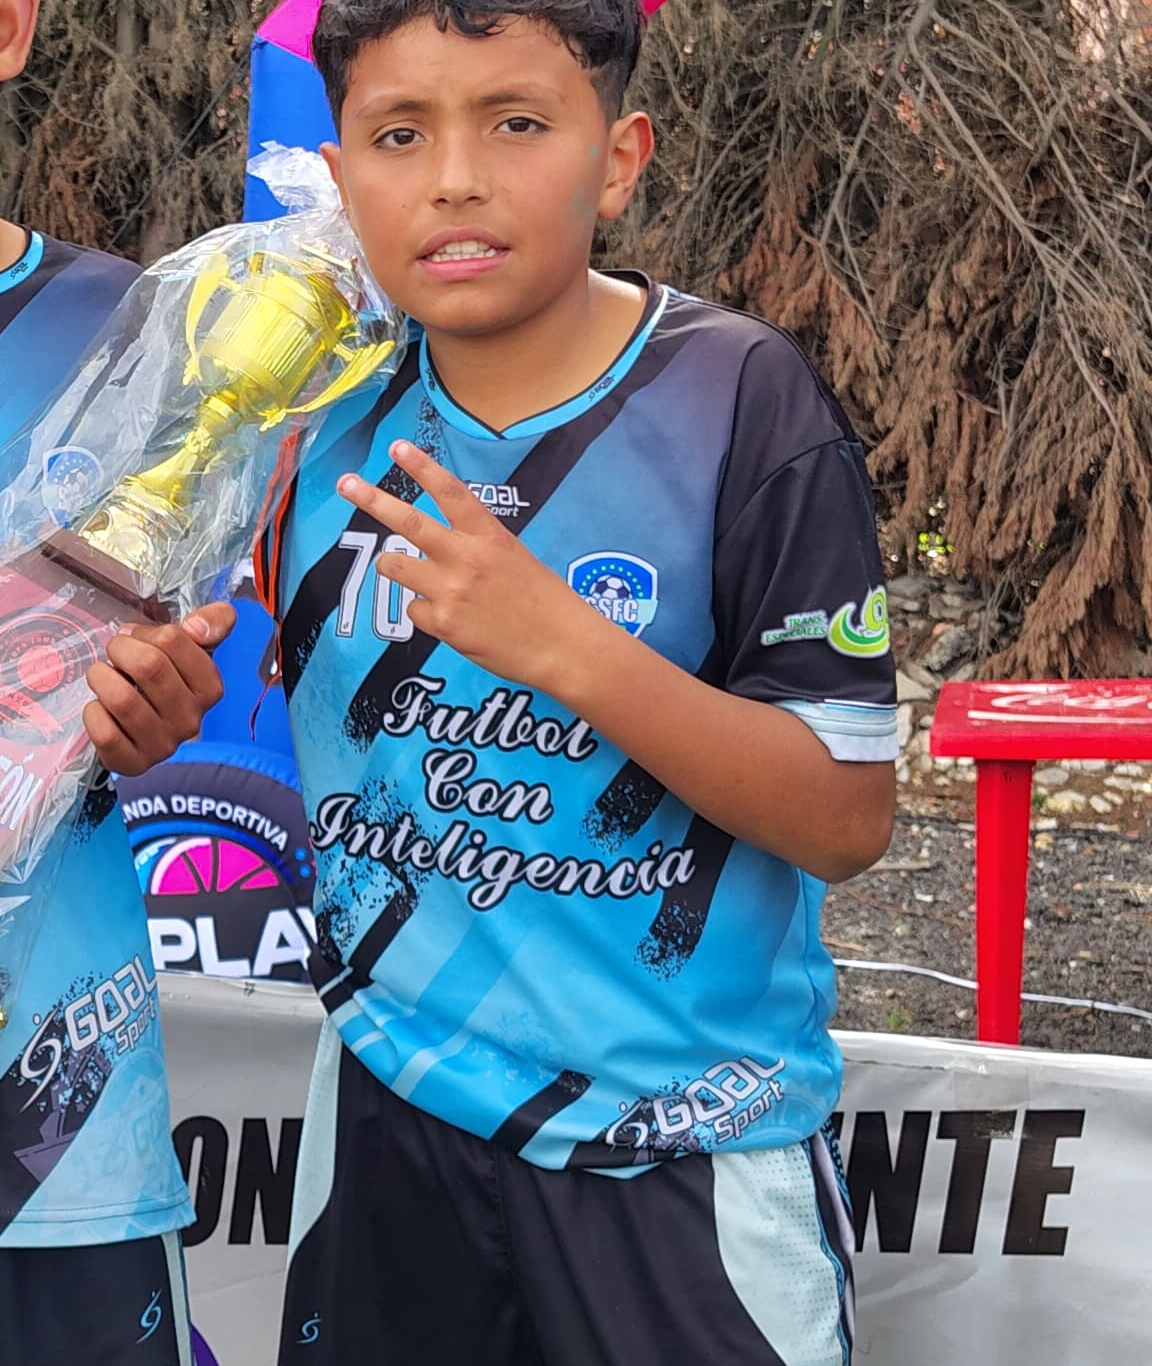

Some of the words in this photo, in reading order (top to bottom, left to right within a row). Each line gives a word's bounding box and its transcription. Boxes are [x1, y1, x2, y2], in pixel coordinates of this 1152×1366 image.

[381, 672, 600, 761] Futbol
[122, 795, 169, 824] NDA
[171, 793, 289, 852] DEPORTIVA
[421, 747, 556, 825] Con
[309, 791, 699, 912] Inteligencia
[64, 955, 158, 1052] GOAL
[653, 1056, 786, 1136] GOAL
[712, 1081, 785, 1144] Sport
[824, 1109, 1087, 1256] NTE
